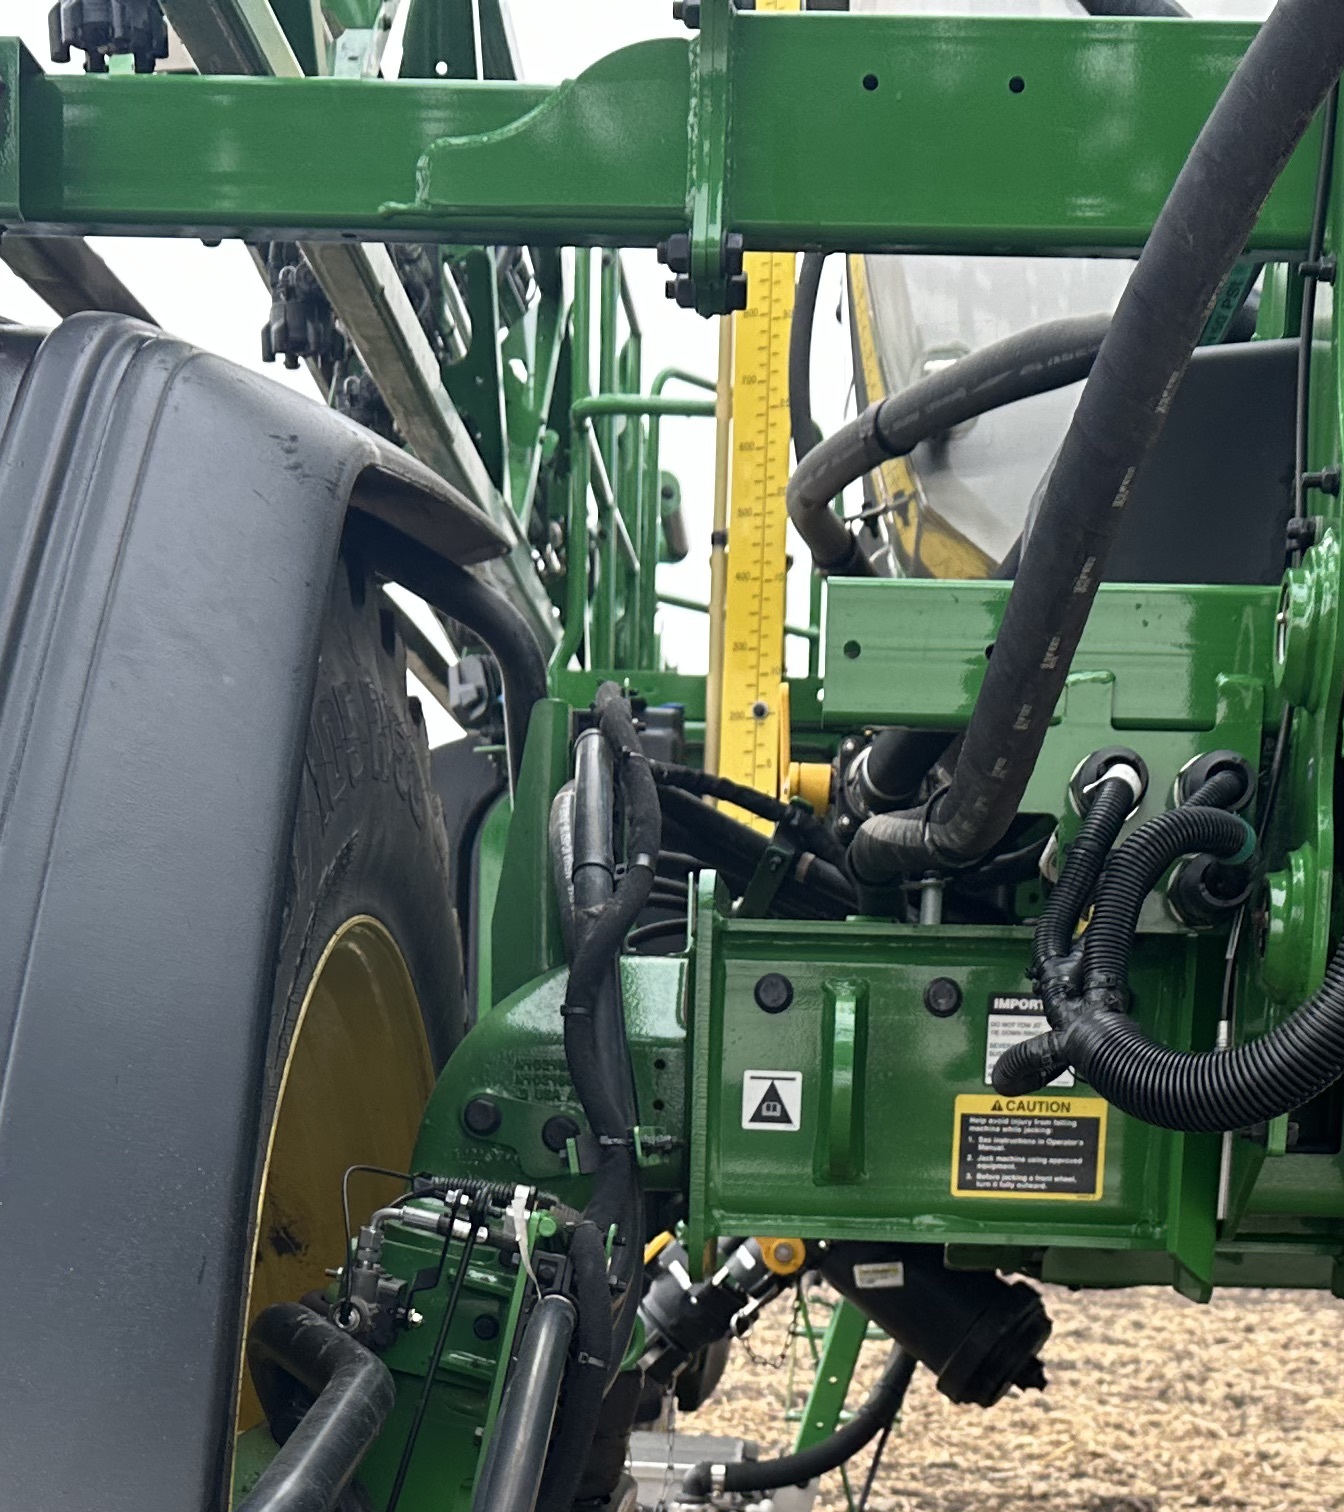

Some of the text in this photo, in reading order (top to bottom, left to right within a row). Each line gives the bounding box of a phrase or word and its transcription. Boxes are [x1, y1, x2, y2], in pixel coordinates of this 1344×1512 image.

[1006, 1099, 1071, 1113] CAUTION
[988, 1117, 1009, 1125] avoid
[1010, 1118, 1033, 1127] injury
[1034, 1118, 1052, 1126] from
[978, 1135, 992, 1143] See
[993, 1137, 1036, 1145] instructions
[1037, 1137, 1045, 1145] in
[977, 1154, 994, 1162] Jack
[995, 1155, 1026, 1163] machine
[1027, 1156, 1048, 1165] using
[1048, 1156, 1083, 1166] approved
[976, 1172, 1001, 1180] Before
[1001, 1174, 1027, 1183] jacking
[1034, 1174, 1053, 1182] front
[999, 1181, 1015, 1189] fully
